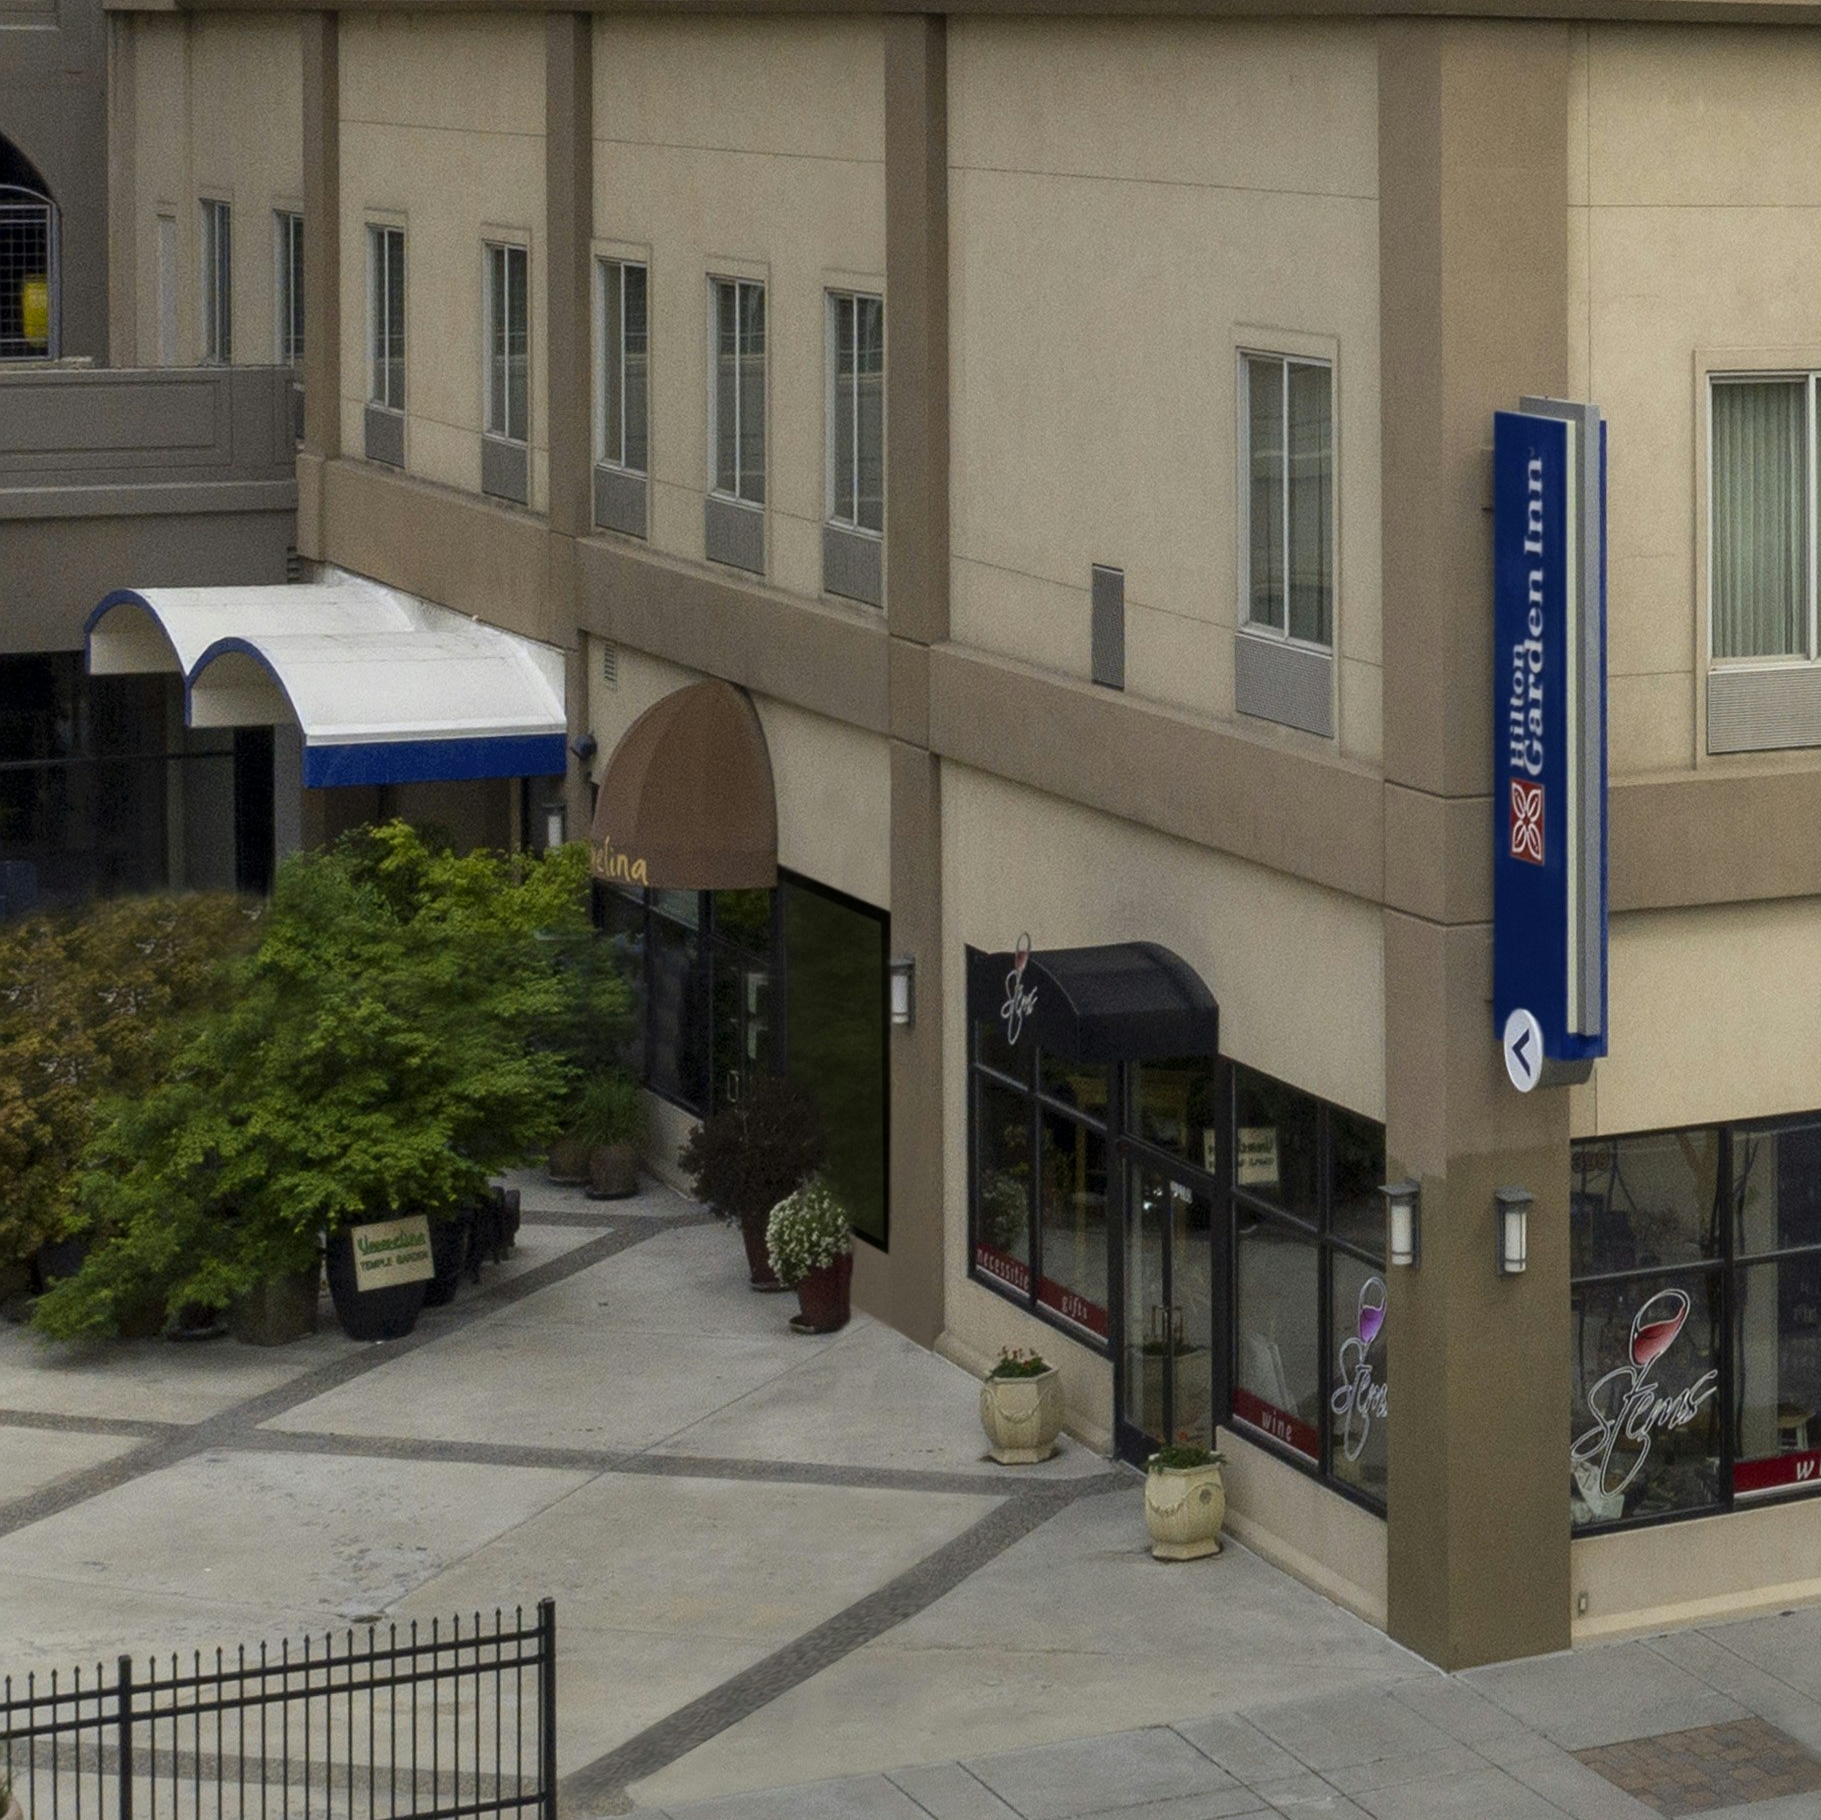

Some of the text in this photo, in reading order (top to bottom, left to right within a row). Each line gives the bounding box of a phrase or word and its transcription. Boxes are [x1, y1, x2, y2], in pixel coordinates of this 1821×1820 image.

[1524, 457, 1543, 776] Garden Inn
[1510, 644, 1525, 768] Hilton
[976, 1248, 1030, 1291] necessitie
[1061, 1295, 1088, 1320] gifts
[1261, 1409, 1293, 1443] wine
[1570, 1366, 1719, 1498] Stems
